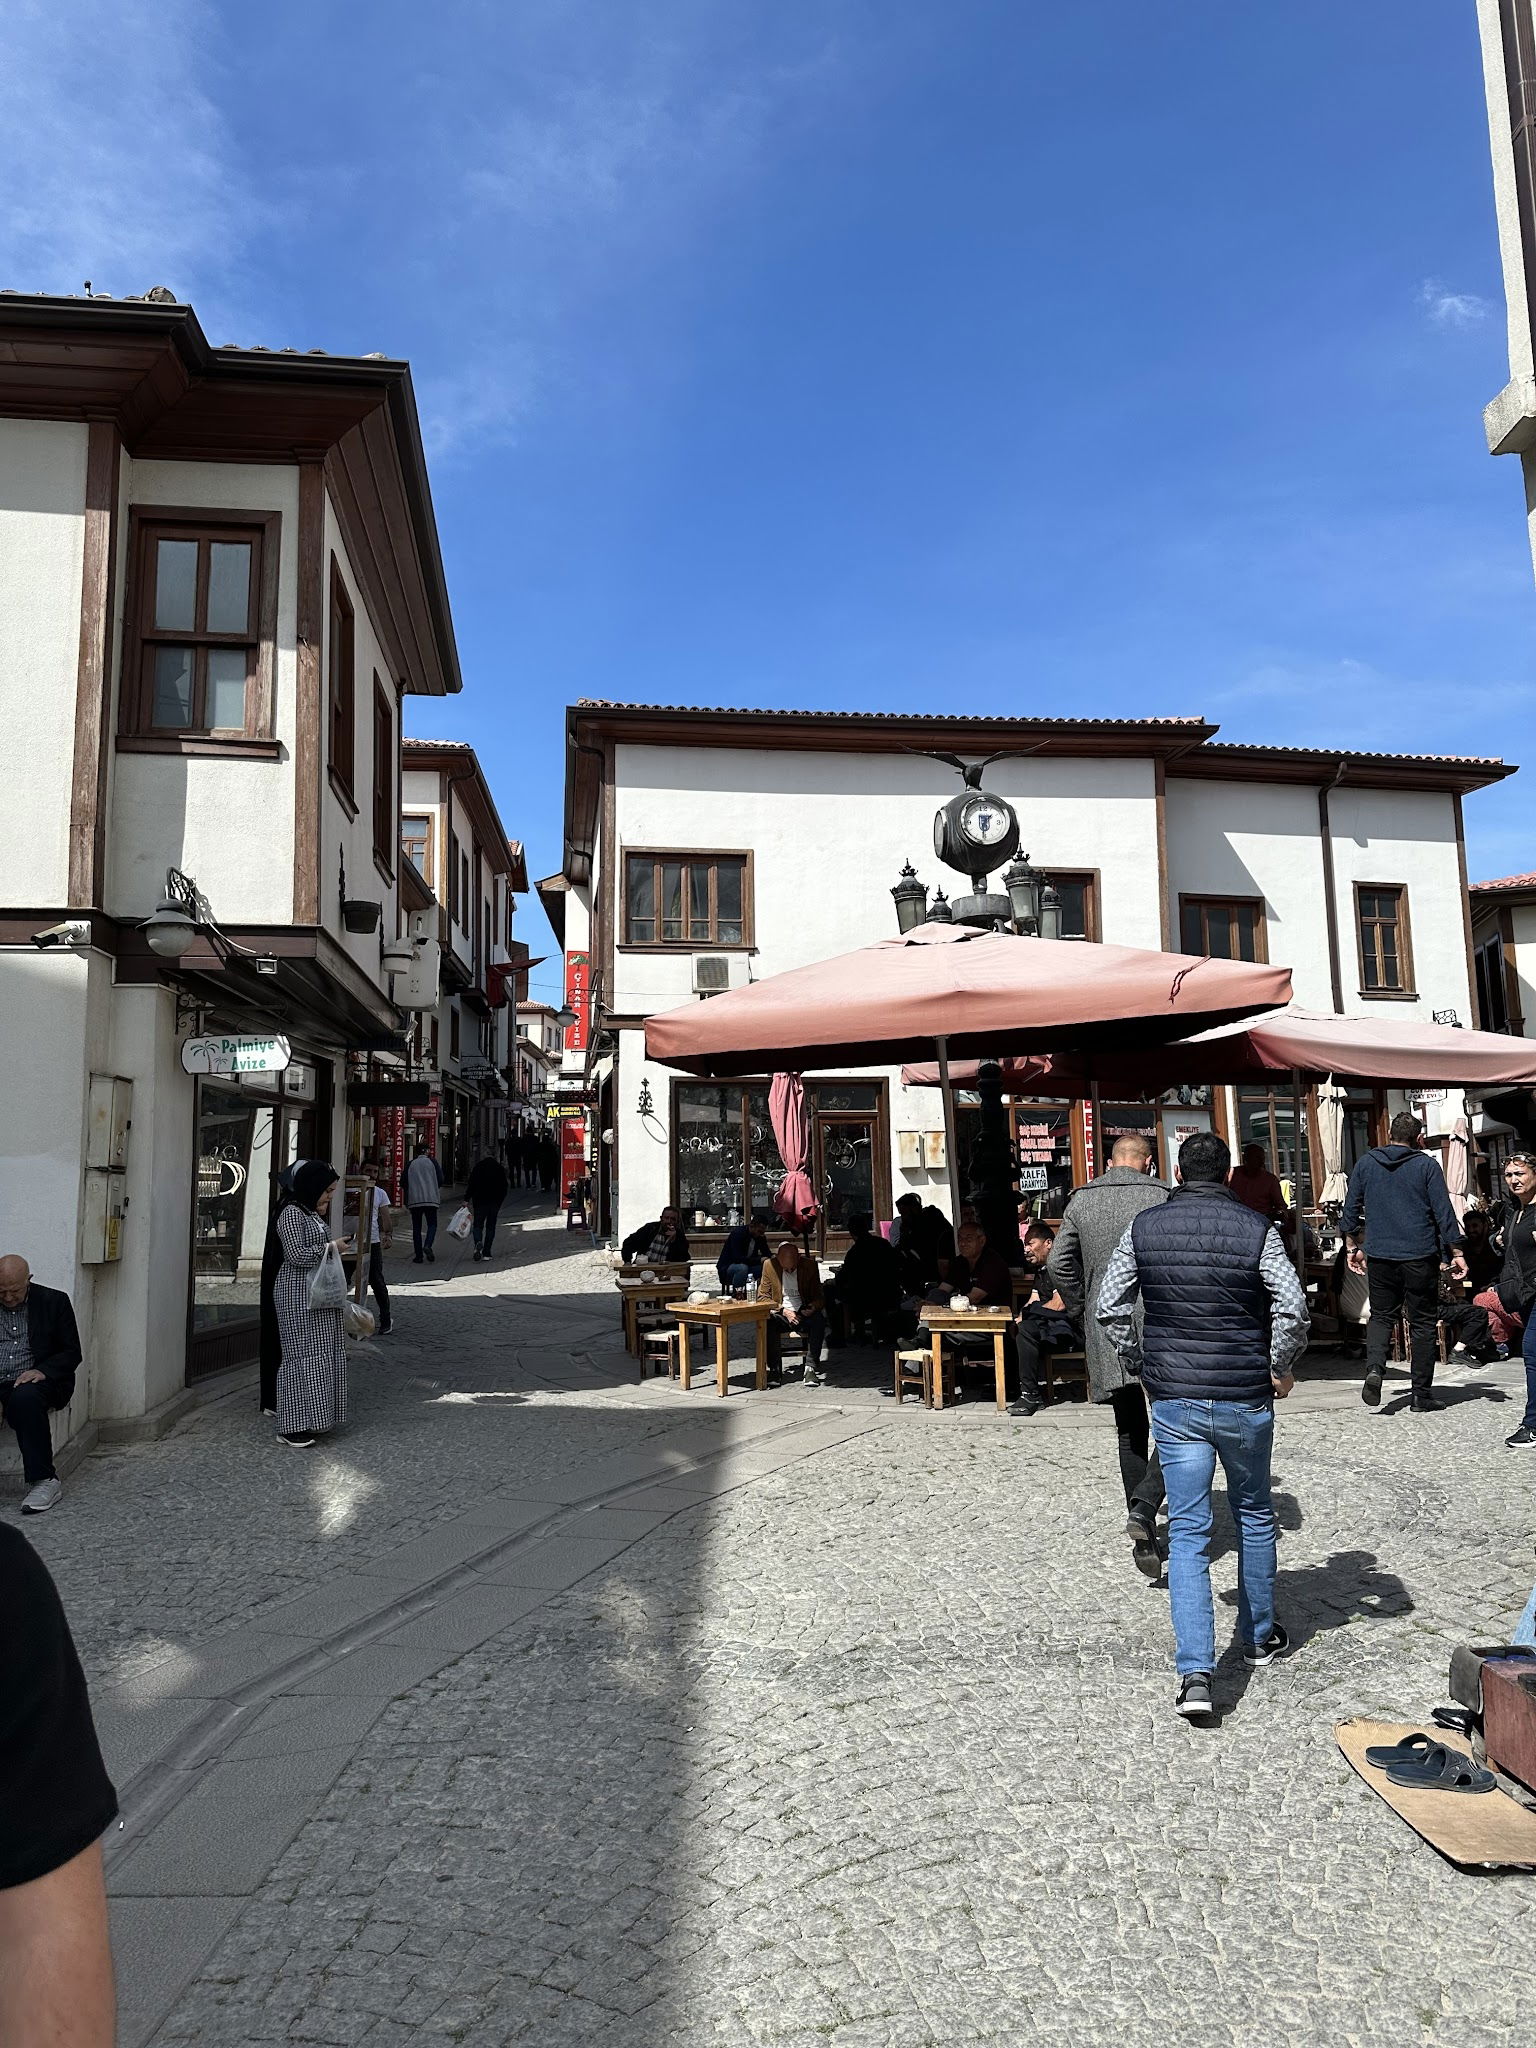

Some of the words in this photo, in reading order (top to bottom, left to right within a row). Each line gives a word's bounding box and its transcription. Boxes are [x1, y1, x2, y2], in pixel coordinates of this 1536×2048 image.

[221, 1038, 275, 1054] Palmiye
[231, 1056, 266, 1071] Avize
[547, 1106, 560, 1118] AK
[1021, 1169, 1046, 1179] KALFA
